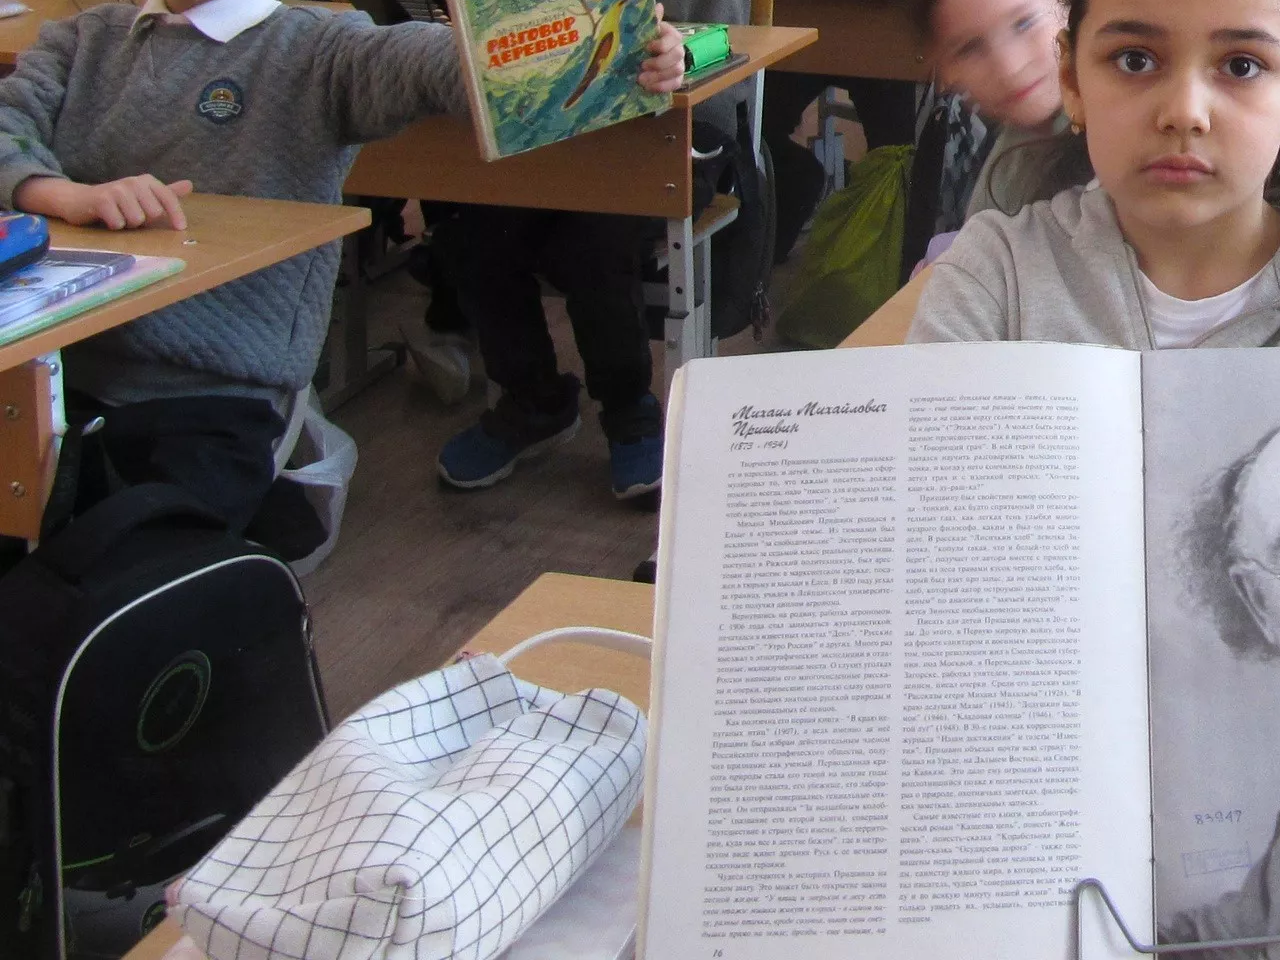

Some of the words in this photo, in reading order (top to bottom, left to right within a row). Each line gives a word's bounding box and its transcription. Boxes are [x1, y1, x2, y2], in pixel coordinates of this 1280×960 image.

[487, 16, 576, 54] РАЗГОВОР
[488, 29, 579, 69] ДЕРЕВЬЕВ
[732, 403, 792, 421] Михаил
[796, 398, 888, 419] Михайлович
[732, 419, 800, 438] Пришвин
